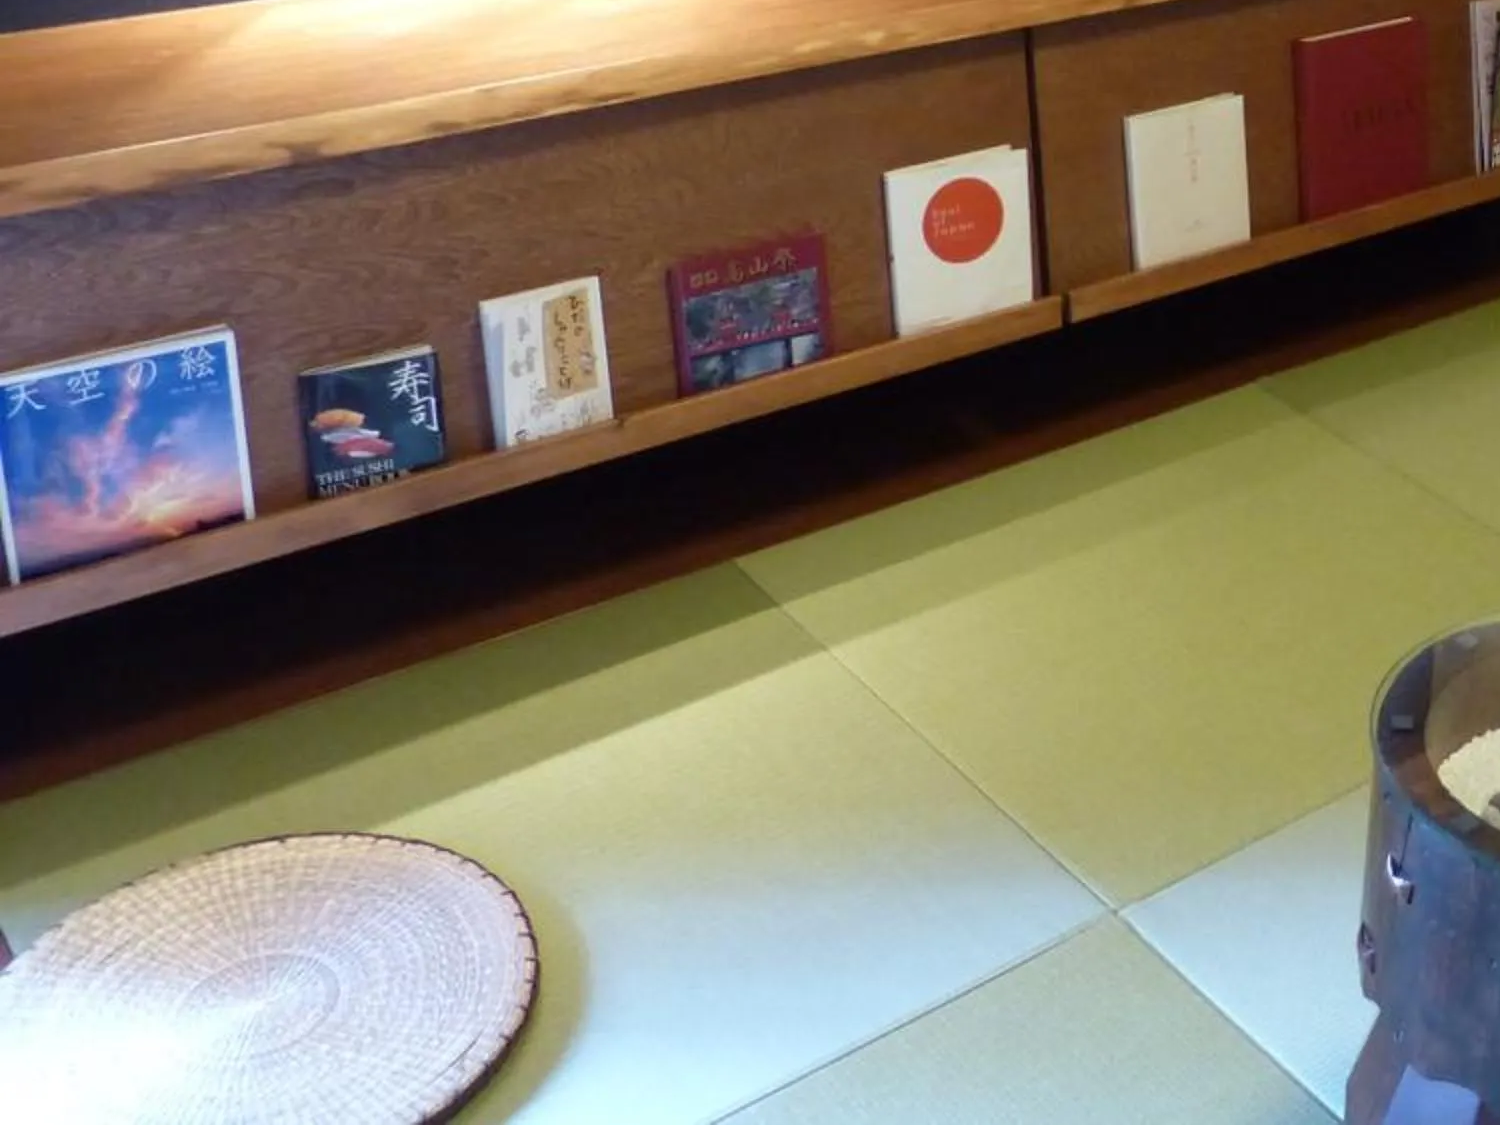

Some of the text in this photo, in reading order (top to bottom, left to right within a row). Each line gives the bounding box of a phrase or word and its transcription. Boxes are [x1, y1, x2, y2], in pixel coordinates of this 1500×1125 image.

[7, 347, 217, 417] 天空の絵
[388, 360, 440, 432] 寿司
[351, 458, 395, 477] SUSHI
